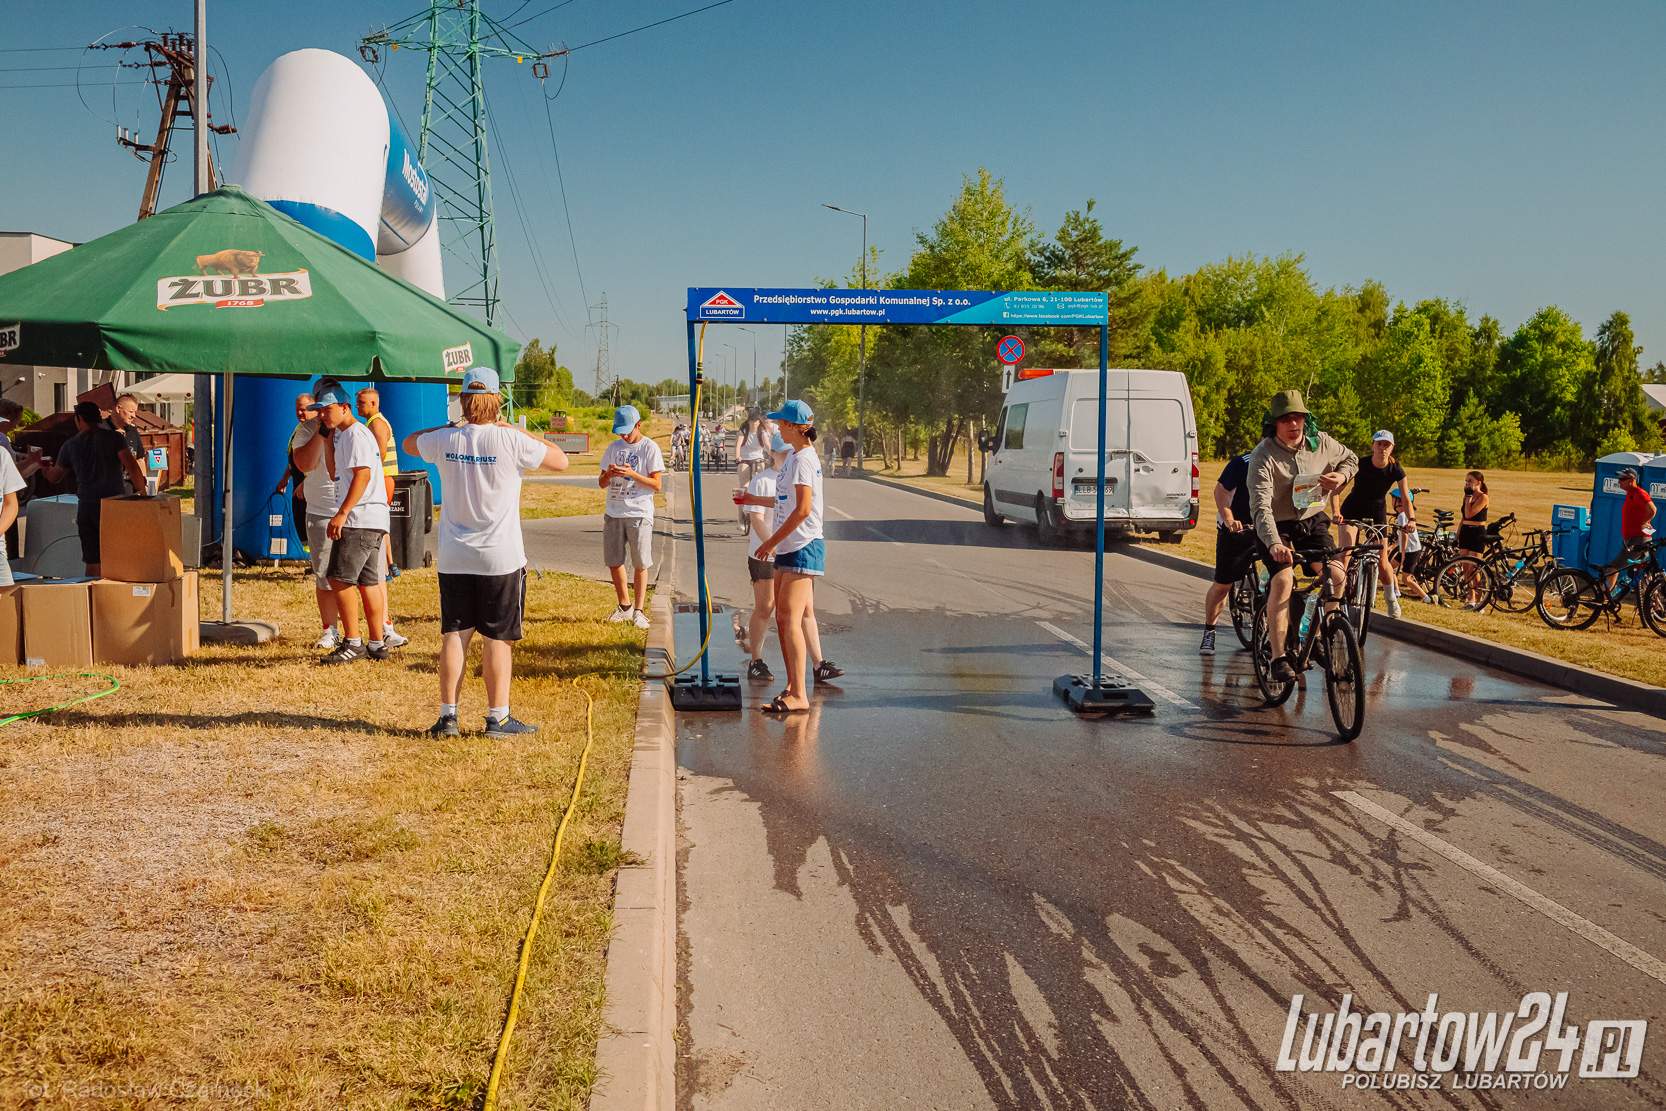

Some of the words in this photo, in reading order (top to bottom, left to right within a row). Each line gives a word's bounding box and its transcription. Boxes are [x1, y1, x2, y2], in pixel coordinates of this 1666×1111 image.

[753, 294, 827, 305] Przedsiębiorstwo
[829, 296, 877, 305] Gospodarki
[879, 296, 930, 306] Komunalnej
[932, 297, 946, 306] Sp.
[810, 307, 886, 316] www.pgk.lubartow.pl
[0, 330, 17, 348] BR
